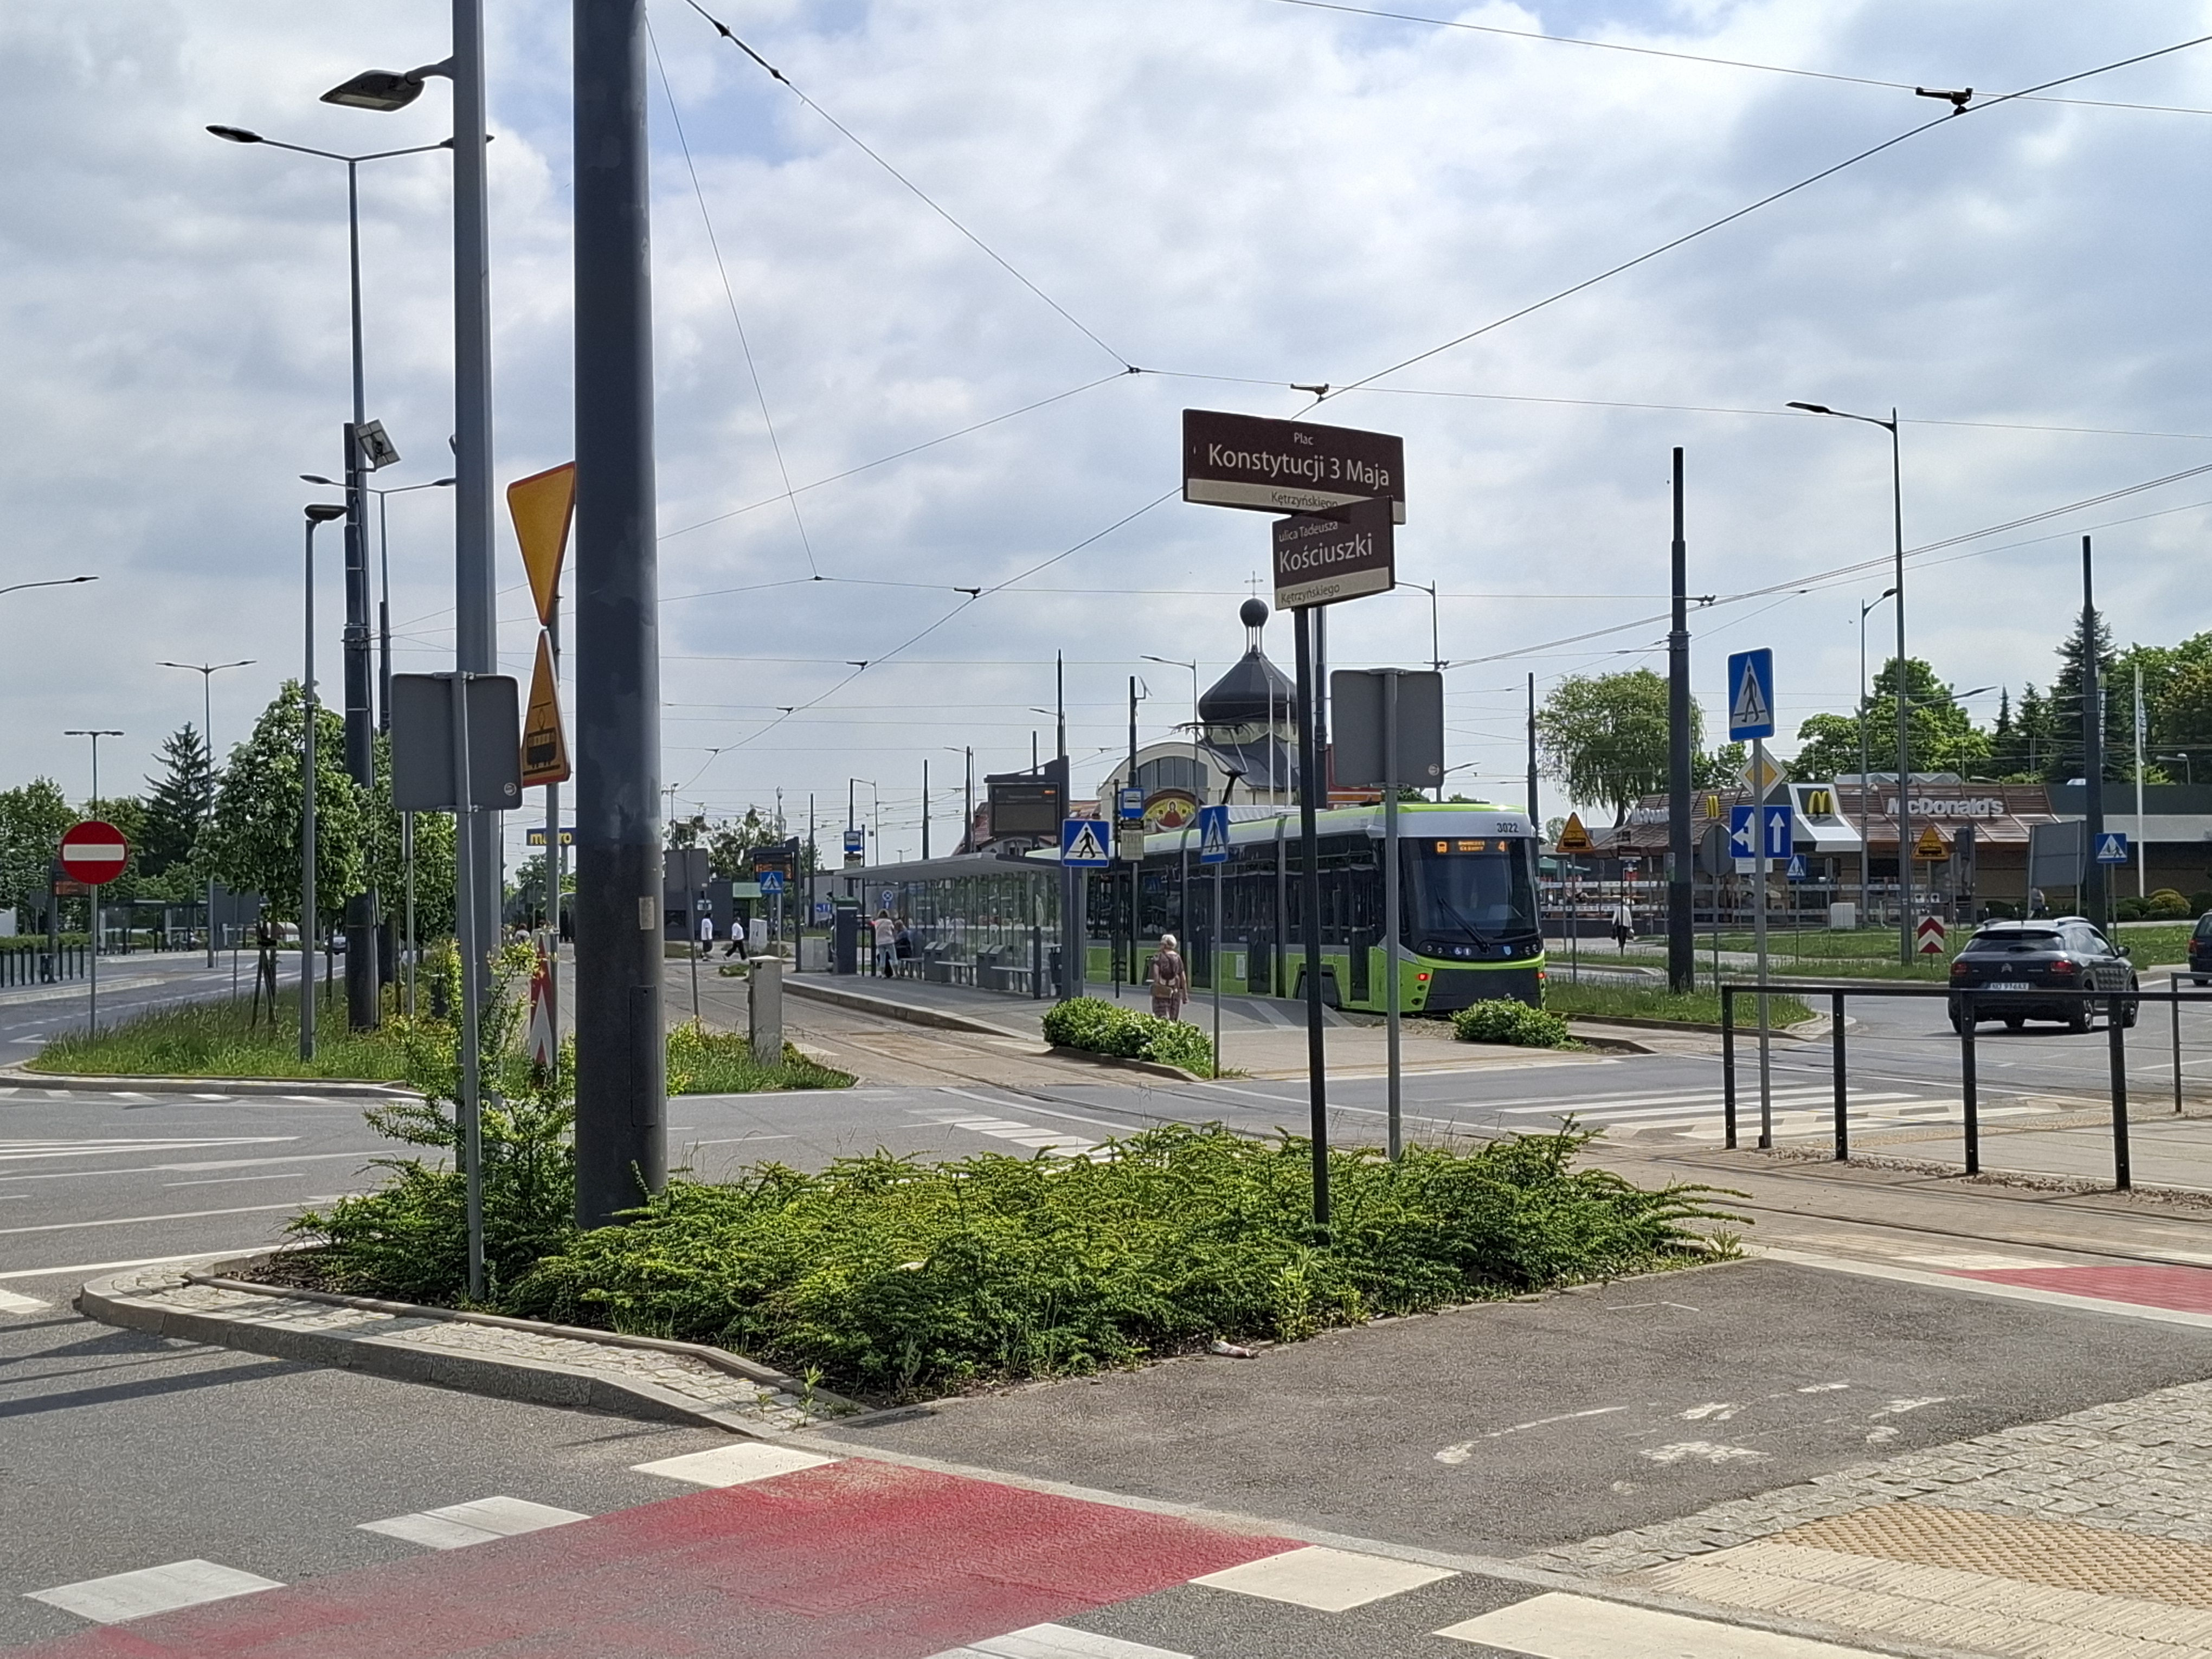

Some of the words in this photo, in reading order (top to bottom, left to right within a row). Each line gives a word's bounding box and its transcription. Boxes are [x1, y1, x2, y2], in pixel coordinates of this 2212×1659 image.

[1294, 432, 1314, 446] Plac
[1209, 443, 1324, 483] Konstytucji
[1330, 458, 1340, 479] 3
[1347, 459, 1389, 490] Maja
[1278, 532, 1298, 542] ulica
[1301, 520, 1338, 538] Tadeusza
[1279, 533, 1372, 573] Kościuszki
[1281, 584, 1340, 605] Kętrzyńskiego
[1887, 798, 2003, 814] McDonald's
[1496, 822, 1519, 832] 3022
[530, 832, 571, 844] mro
[1498, 841, 1505, 852] 4
